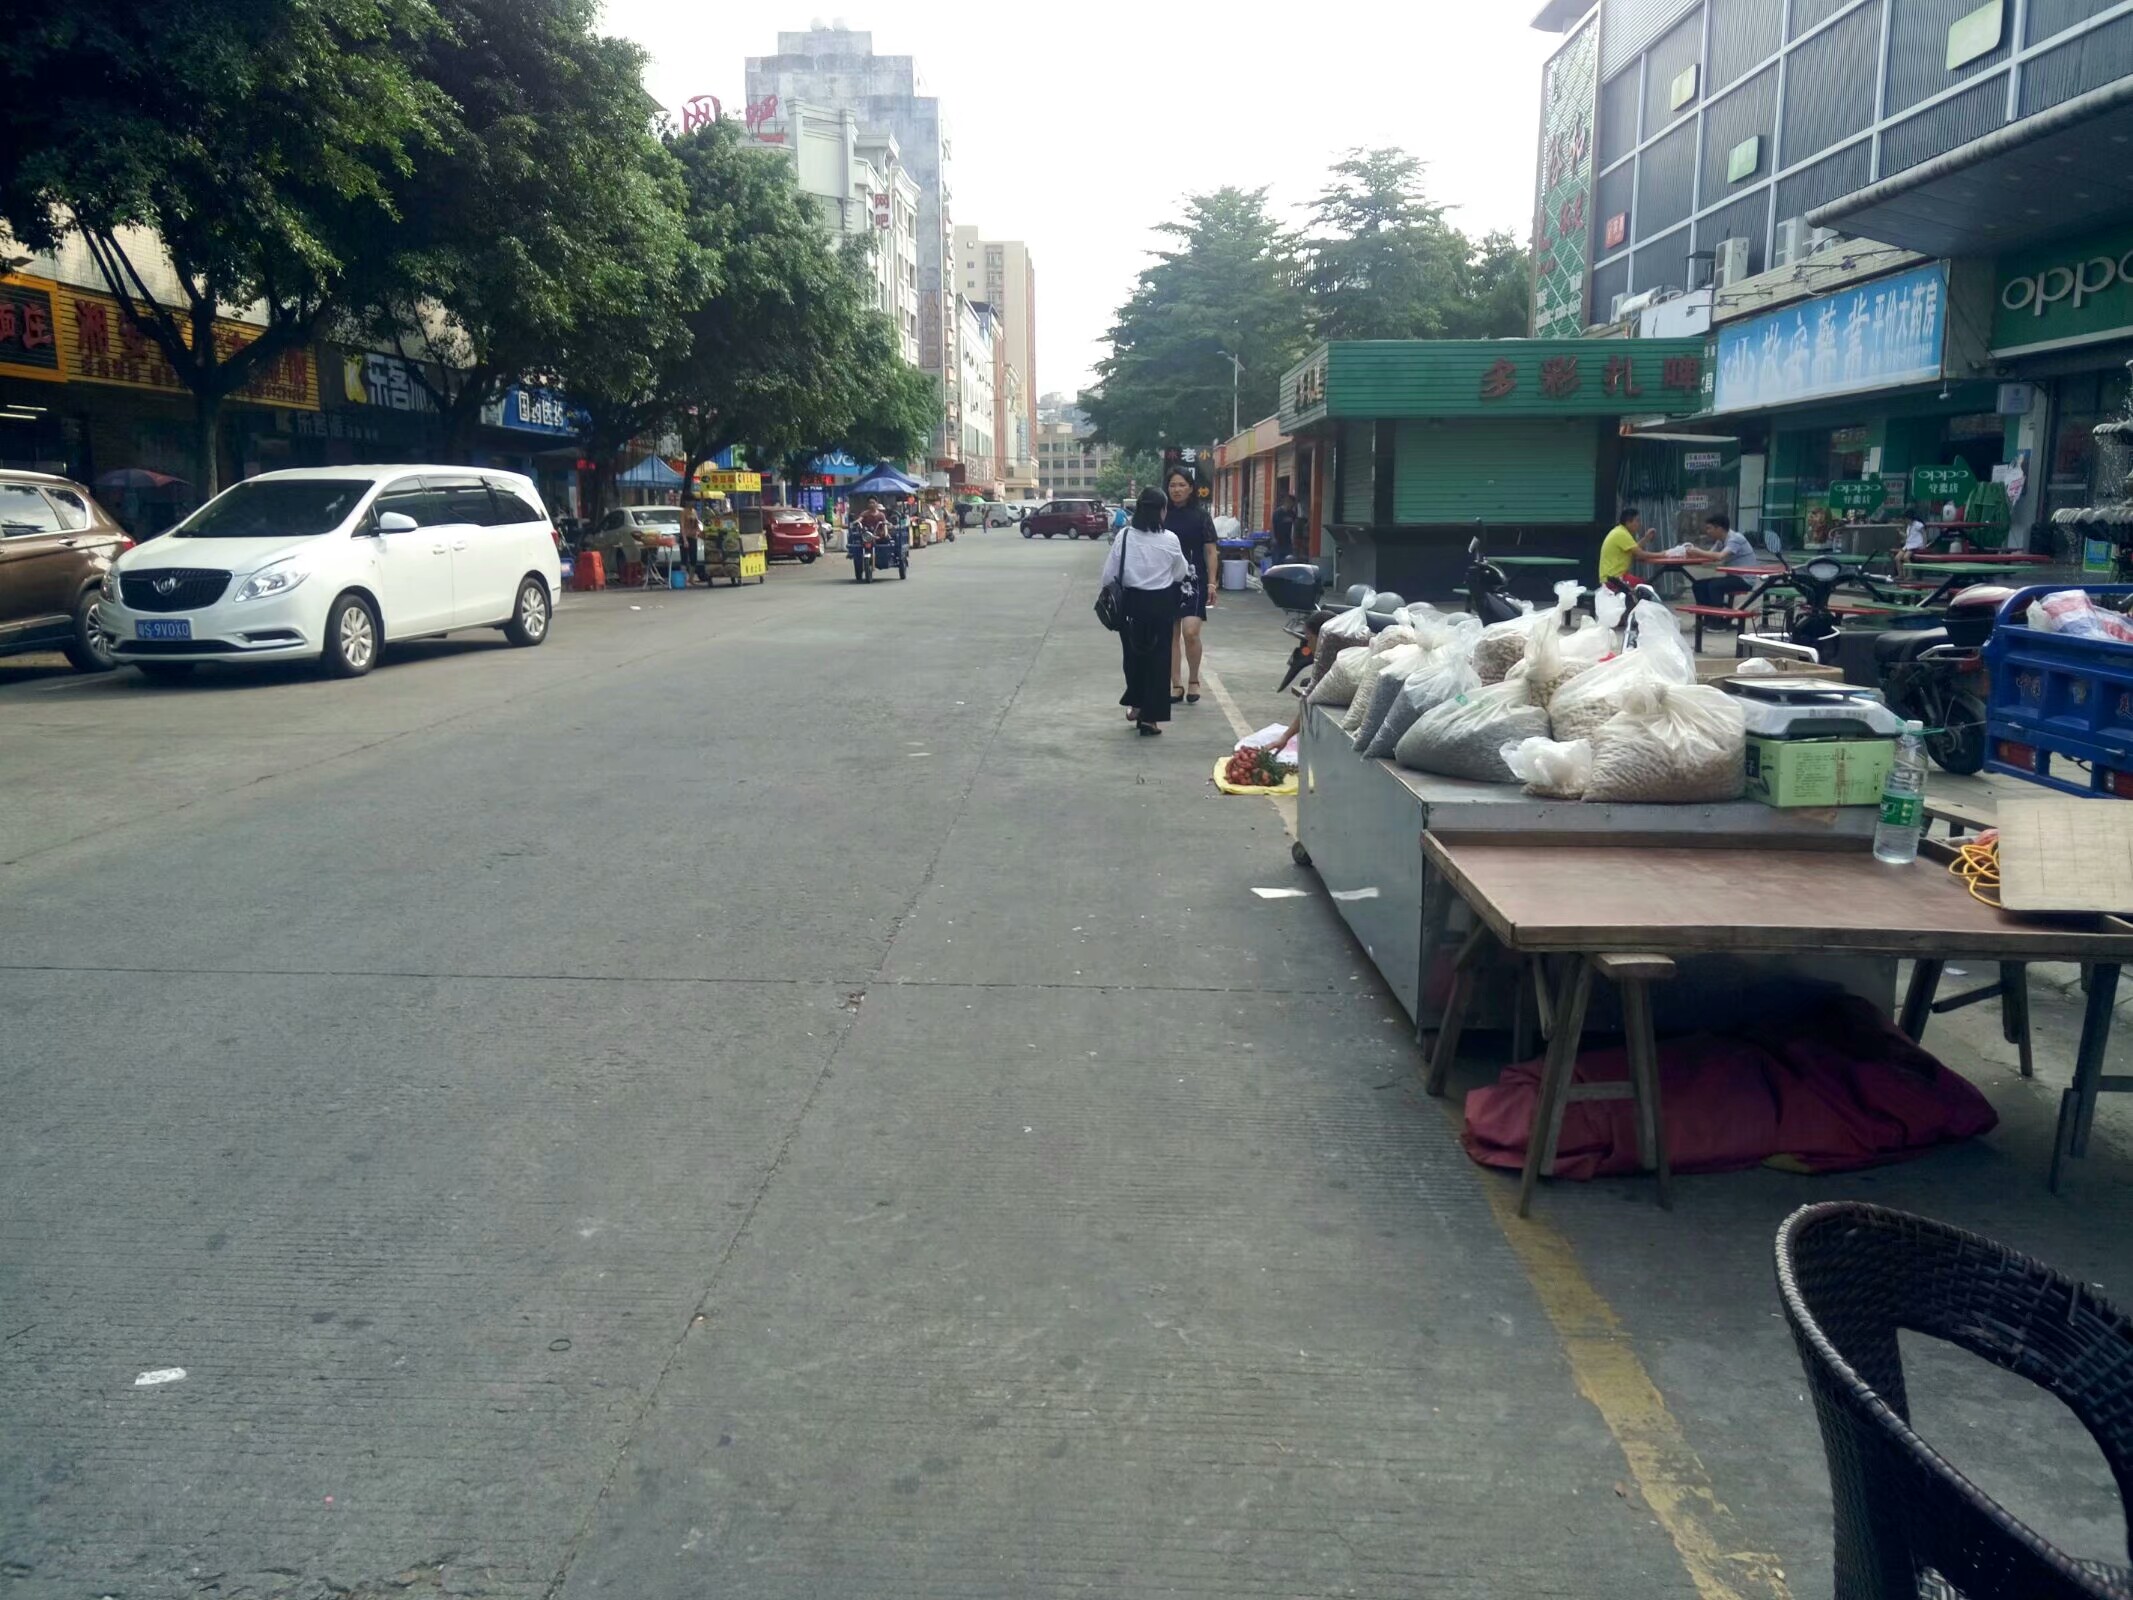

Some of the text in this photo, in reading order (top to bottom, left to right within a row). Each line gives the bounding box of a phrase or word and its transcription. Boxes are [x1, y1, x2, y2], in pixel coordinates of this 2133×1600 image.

[874, 193, 890, 230] 网吧
[1481, 356, 1700, 397] 多彩扎啤
[1918, 470, 1969, 481] oppo
[1834, 484, 1882, 494] oppo
